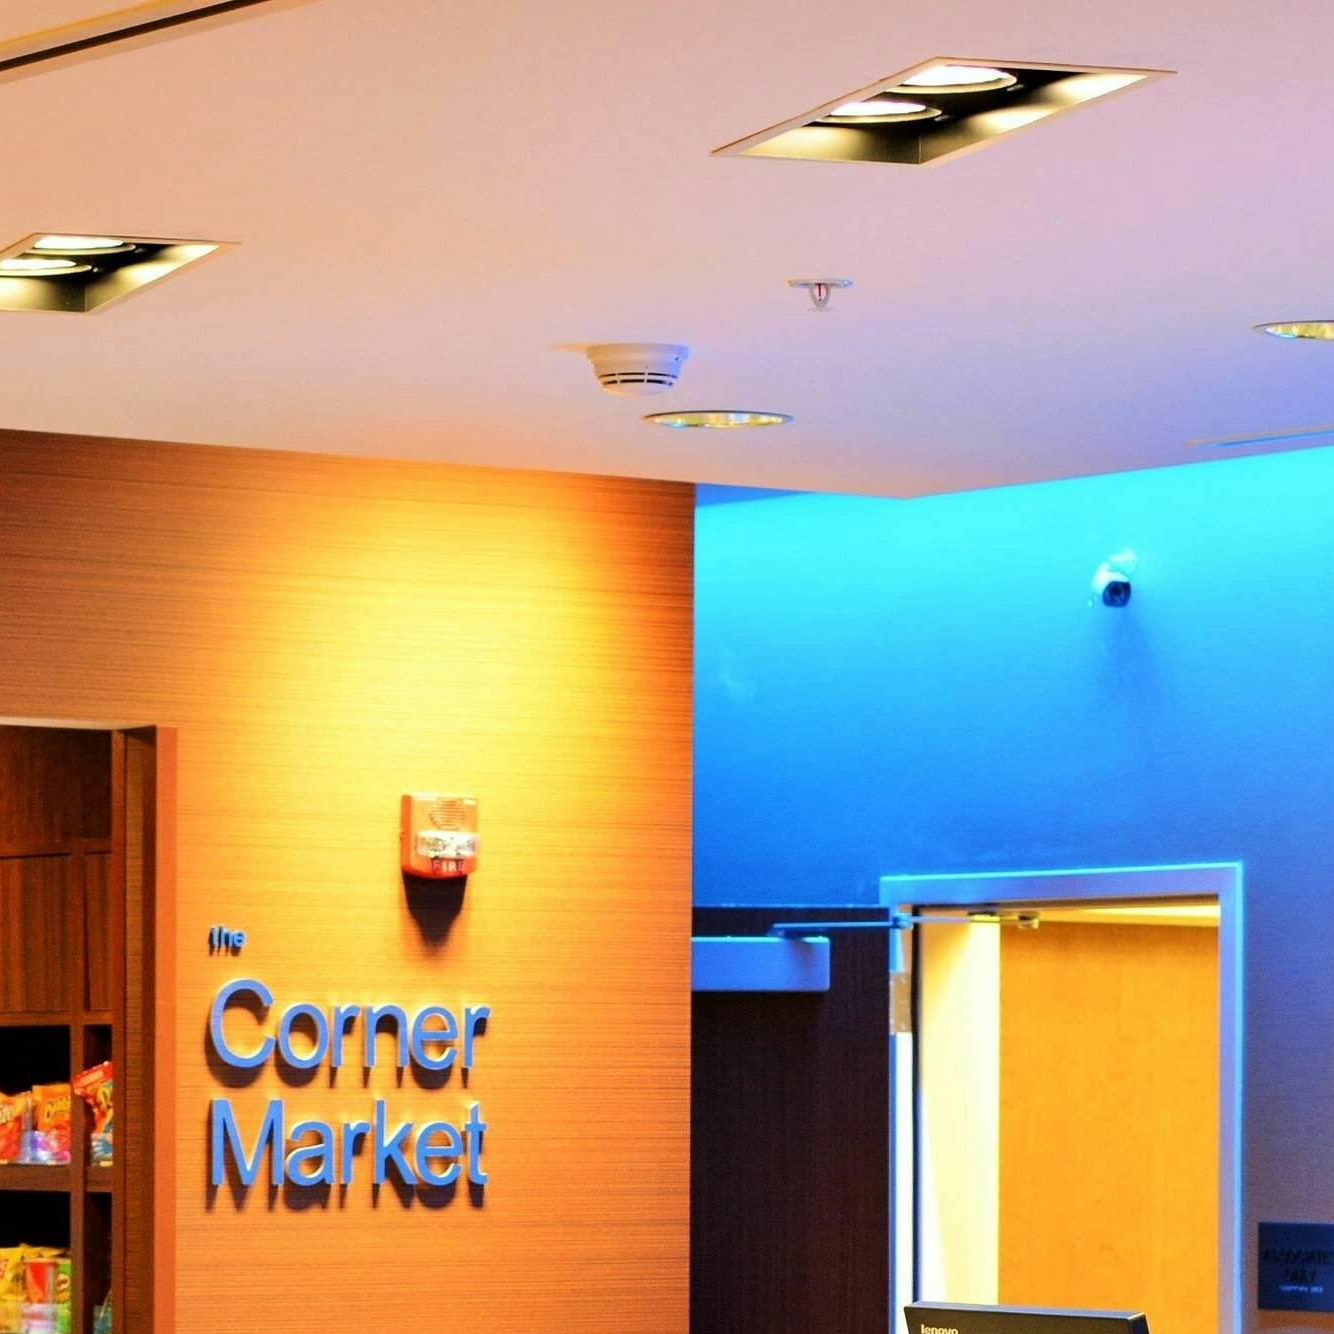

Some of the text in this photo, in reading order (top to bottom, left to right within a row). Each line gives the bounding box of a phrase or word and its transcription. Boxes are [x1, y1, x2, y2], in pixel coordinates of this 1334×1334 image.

[431, 859, 465, 873] FIRE
[209, 926, 246, 948] the
[208, 977, 492, 1071] Corner
[210, 1097, 490, 1187] Market
